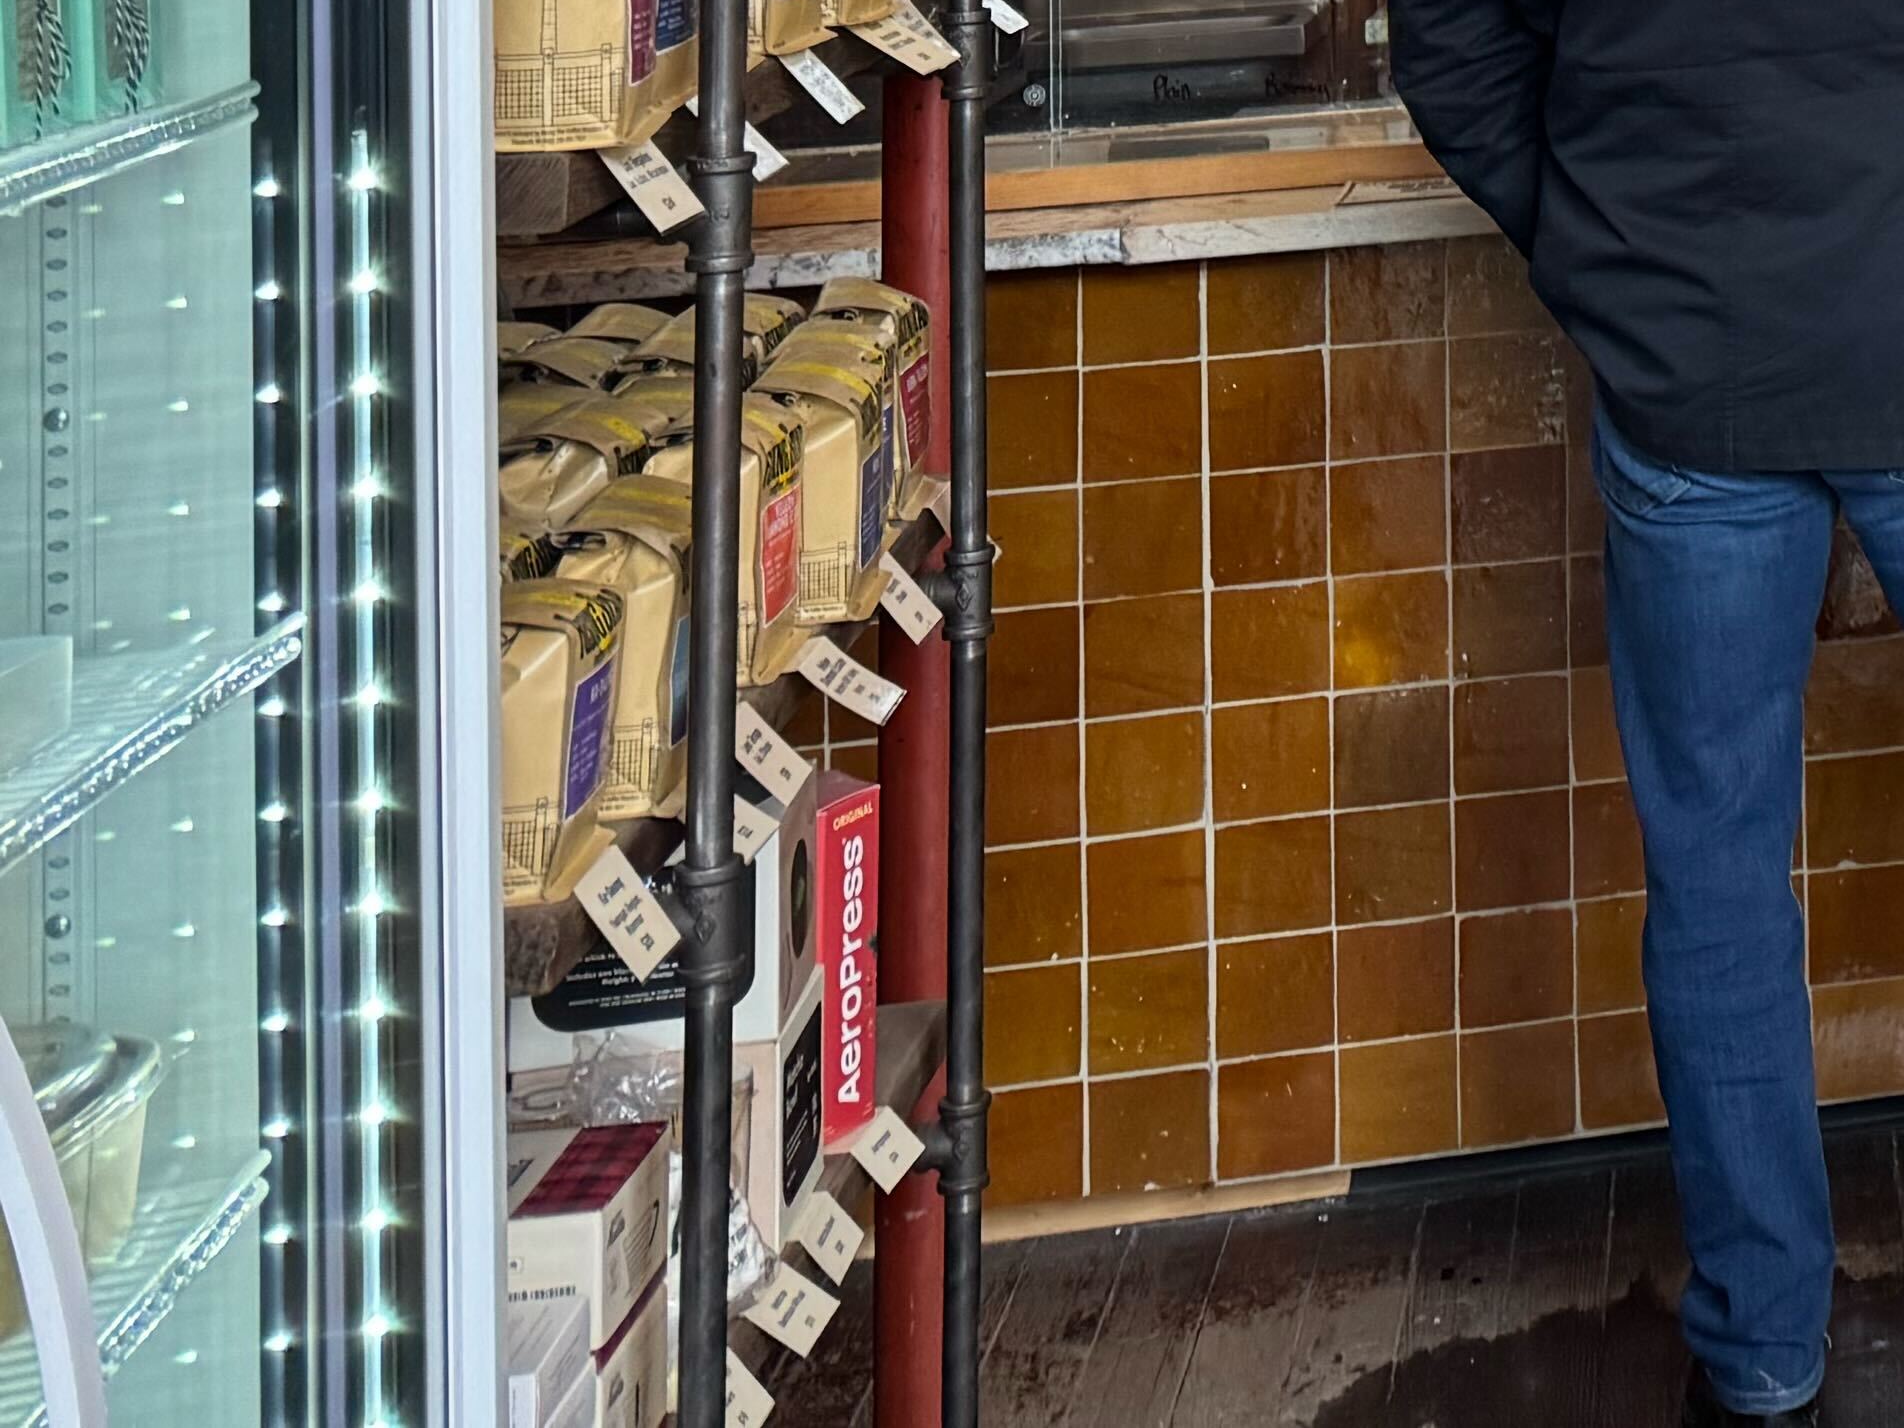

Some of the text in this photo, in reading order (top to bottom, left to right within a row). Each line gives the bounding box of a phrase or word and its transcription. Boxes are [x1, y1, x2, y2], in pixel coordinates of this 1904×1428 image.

[1153, 75, 1191, 101] Plain
[832, 800, 873, 831] ORIGINAL
[838, 833, 865, 1104] AeroPress
